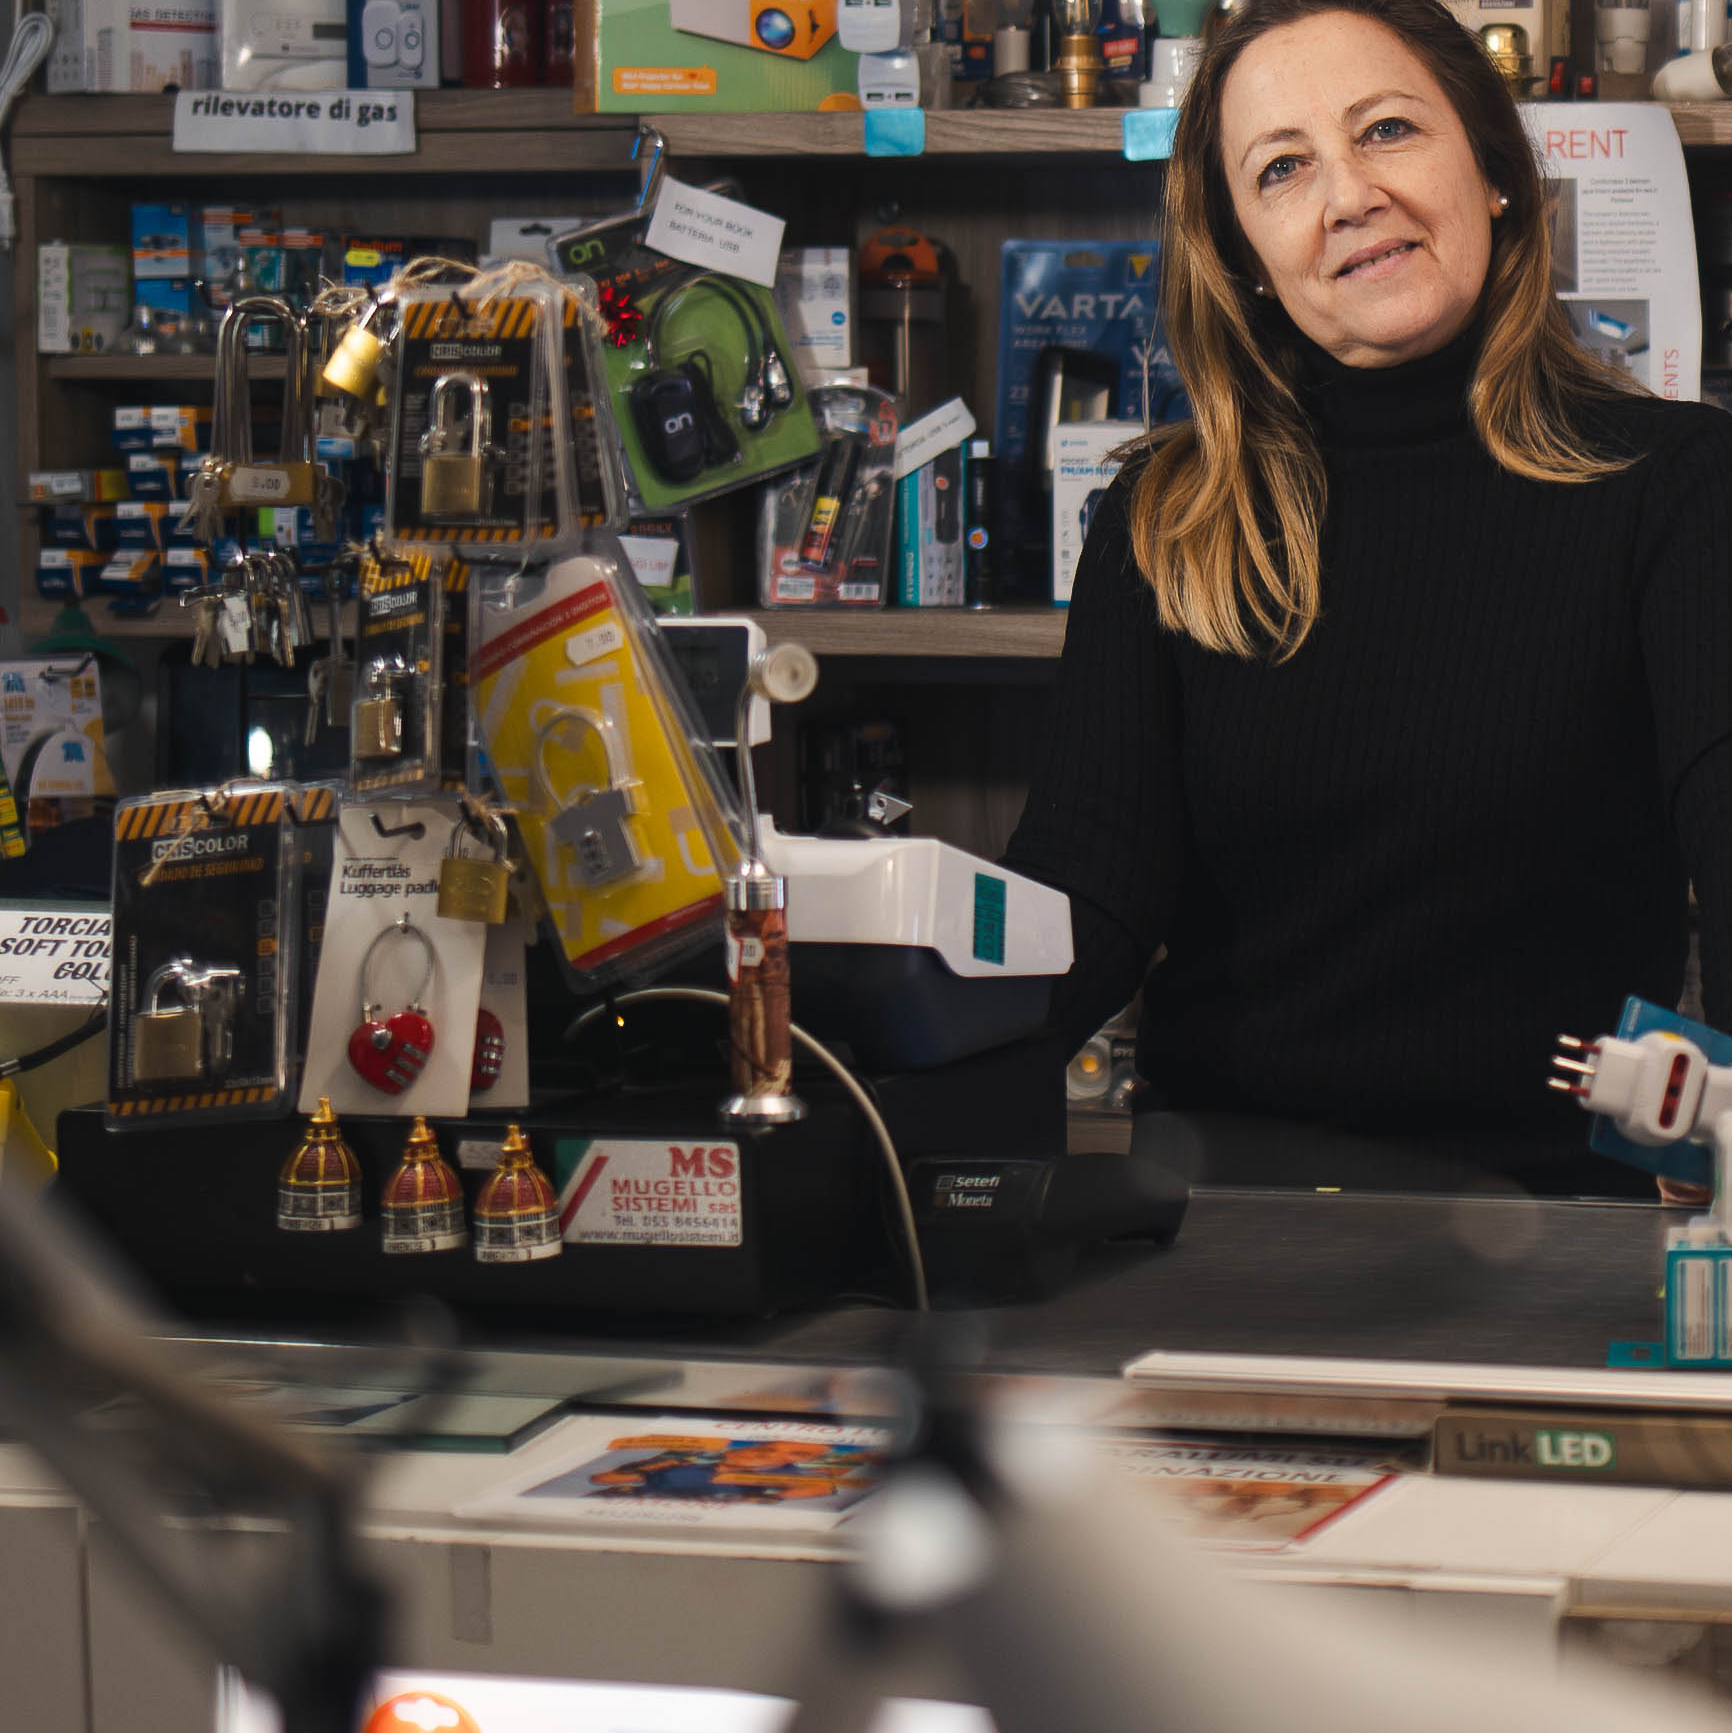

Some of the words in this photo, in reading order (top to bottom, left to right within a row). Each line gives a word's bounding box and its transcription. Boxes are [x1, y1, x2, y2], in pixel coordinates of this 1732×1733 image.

[192, 96, 320, 118] rilevatore
[330, 97, 351, 120] di
[357, 102, 398, 128] gas
[1545, 129, 1629, 160] RENT
[569, 237, 606, 266] on
[1015, 294, 1144, 320] VARTA
[1057, 324, 1087, 334] FLEX
[664, 410, 693, 435] on
[152, 834, 249, 862] CRISCOLOR
[339, 880, 400, 898] Luggage
[18, 916, 110, 936] TORCIA
[0, 937, 62, 956] SOFT
[38, 989, 68, 999] AAA
[669, 1146, 735, 1179] MS
[611, 1179, 736, 1196] MUGELLO
[956, 1175, 1000, 1188] Setefi
[612, 1197, 698, 1213] SISTEMI
[709, 1201, 737, 1214] sas
[947, 1192, 993, 1208] Moneta
[1455, 1431, 1530, 1464] Link
[1537, 1434, 1613, 1466] LED
